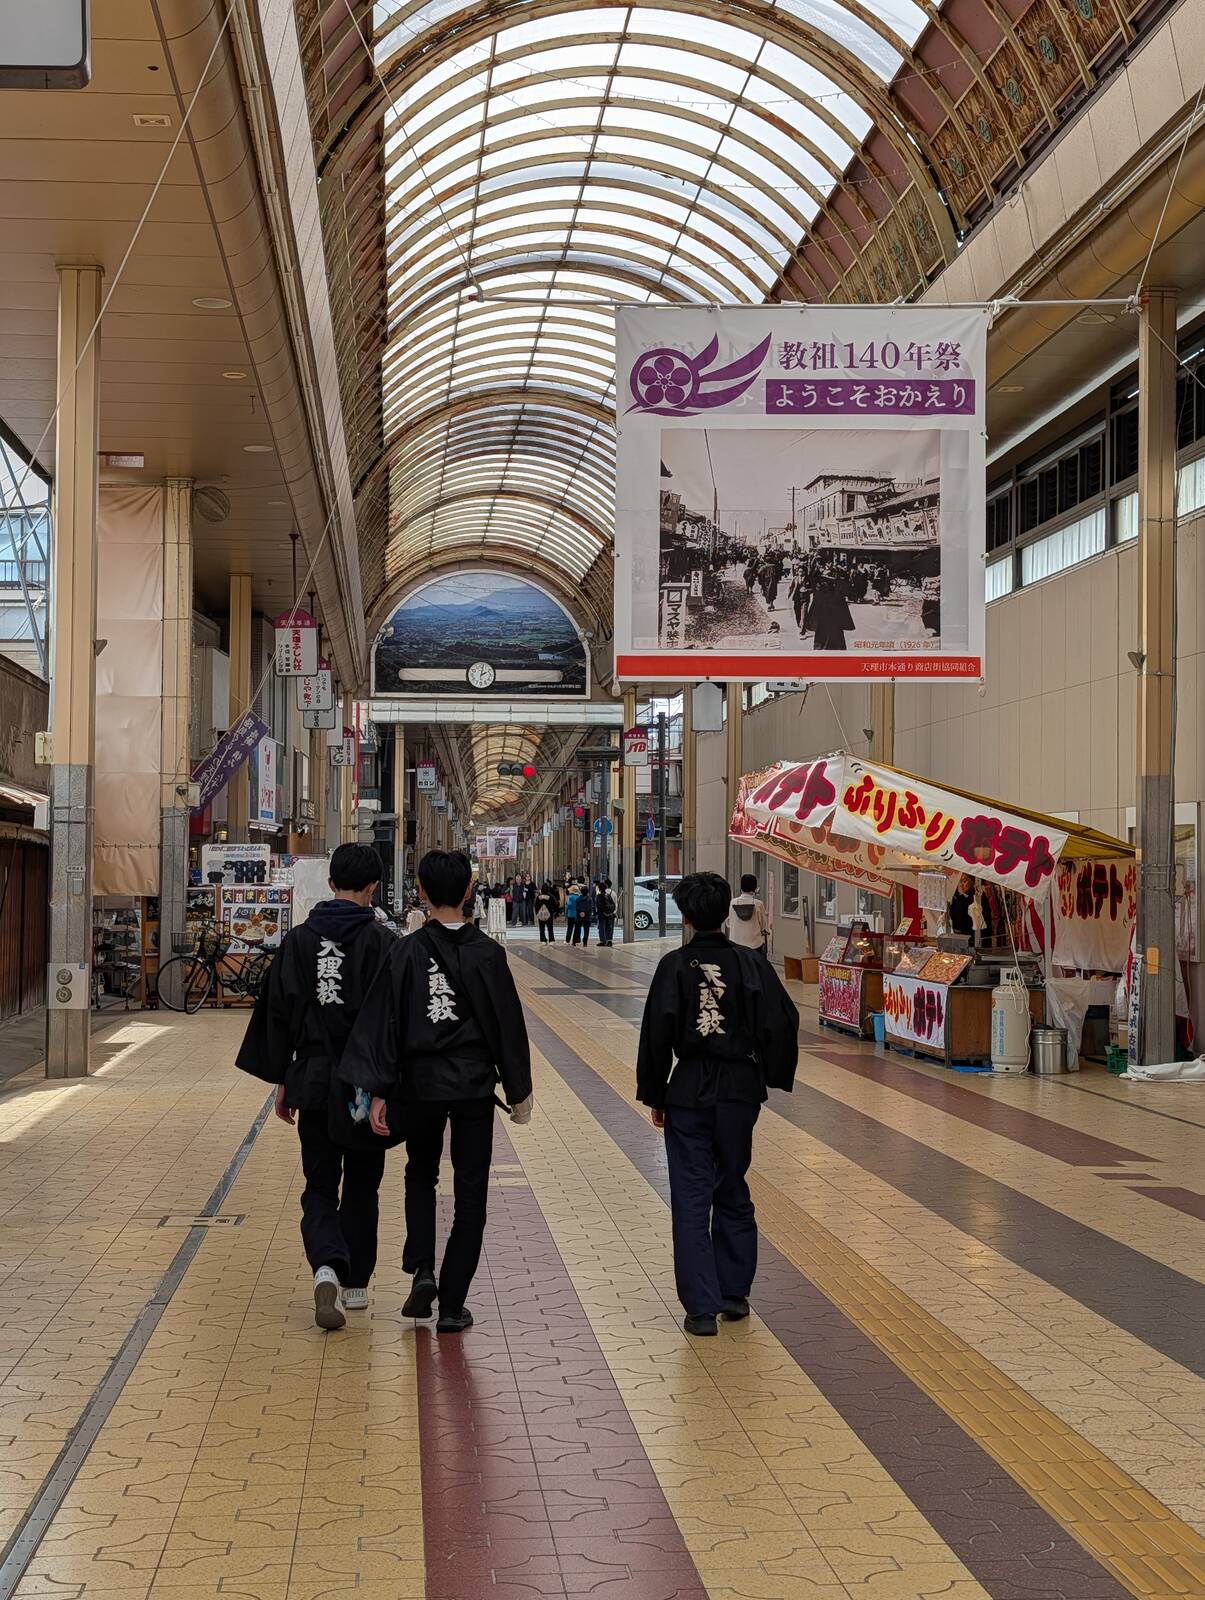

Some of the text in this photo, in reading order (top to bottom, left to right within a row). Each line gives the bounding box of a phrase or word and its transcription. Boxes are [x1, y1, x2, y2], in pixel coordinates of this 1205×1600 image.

[778, 341, 961, 371] 教祖140年祭
[776, 383, 966, 408] ようこそおかえり
[861, 662, 976, 673] 天理市本通り商店街協同組合
[626, 742, 647, 754] JTB
